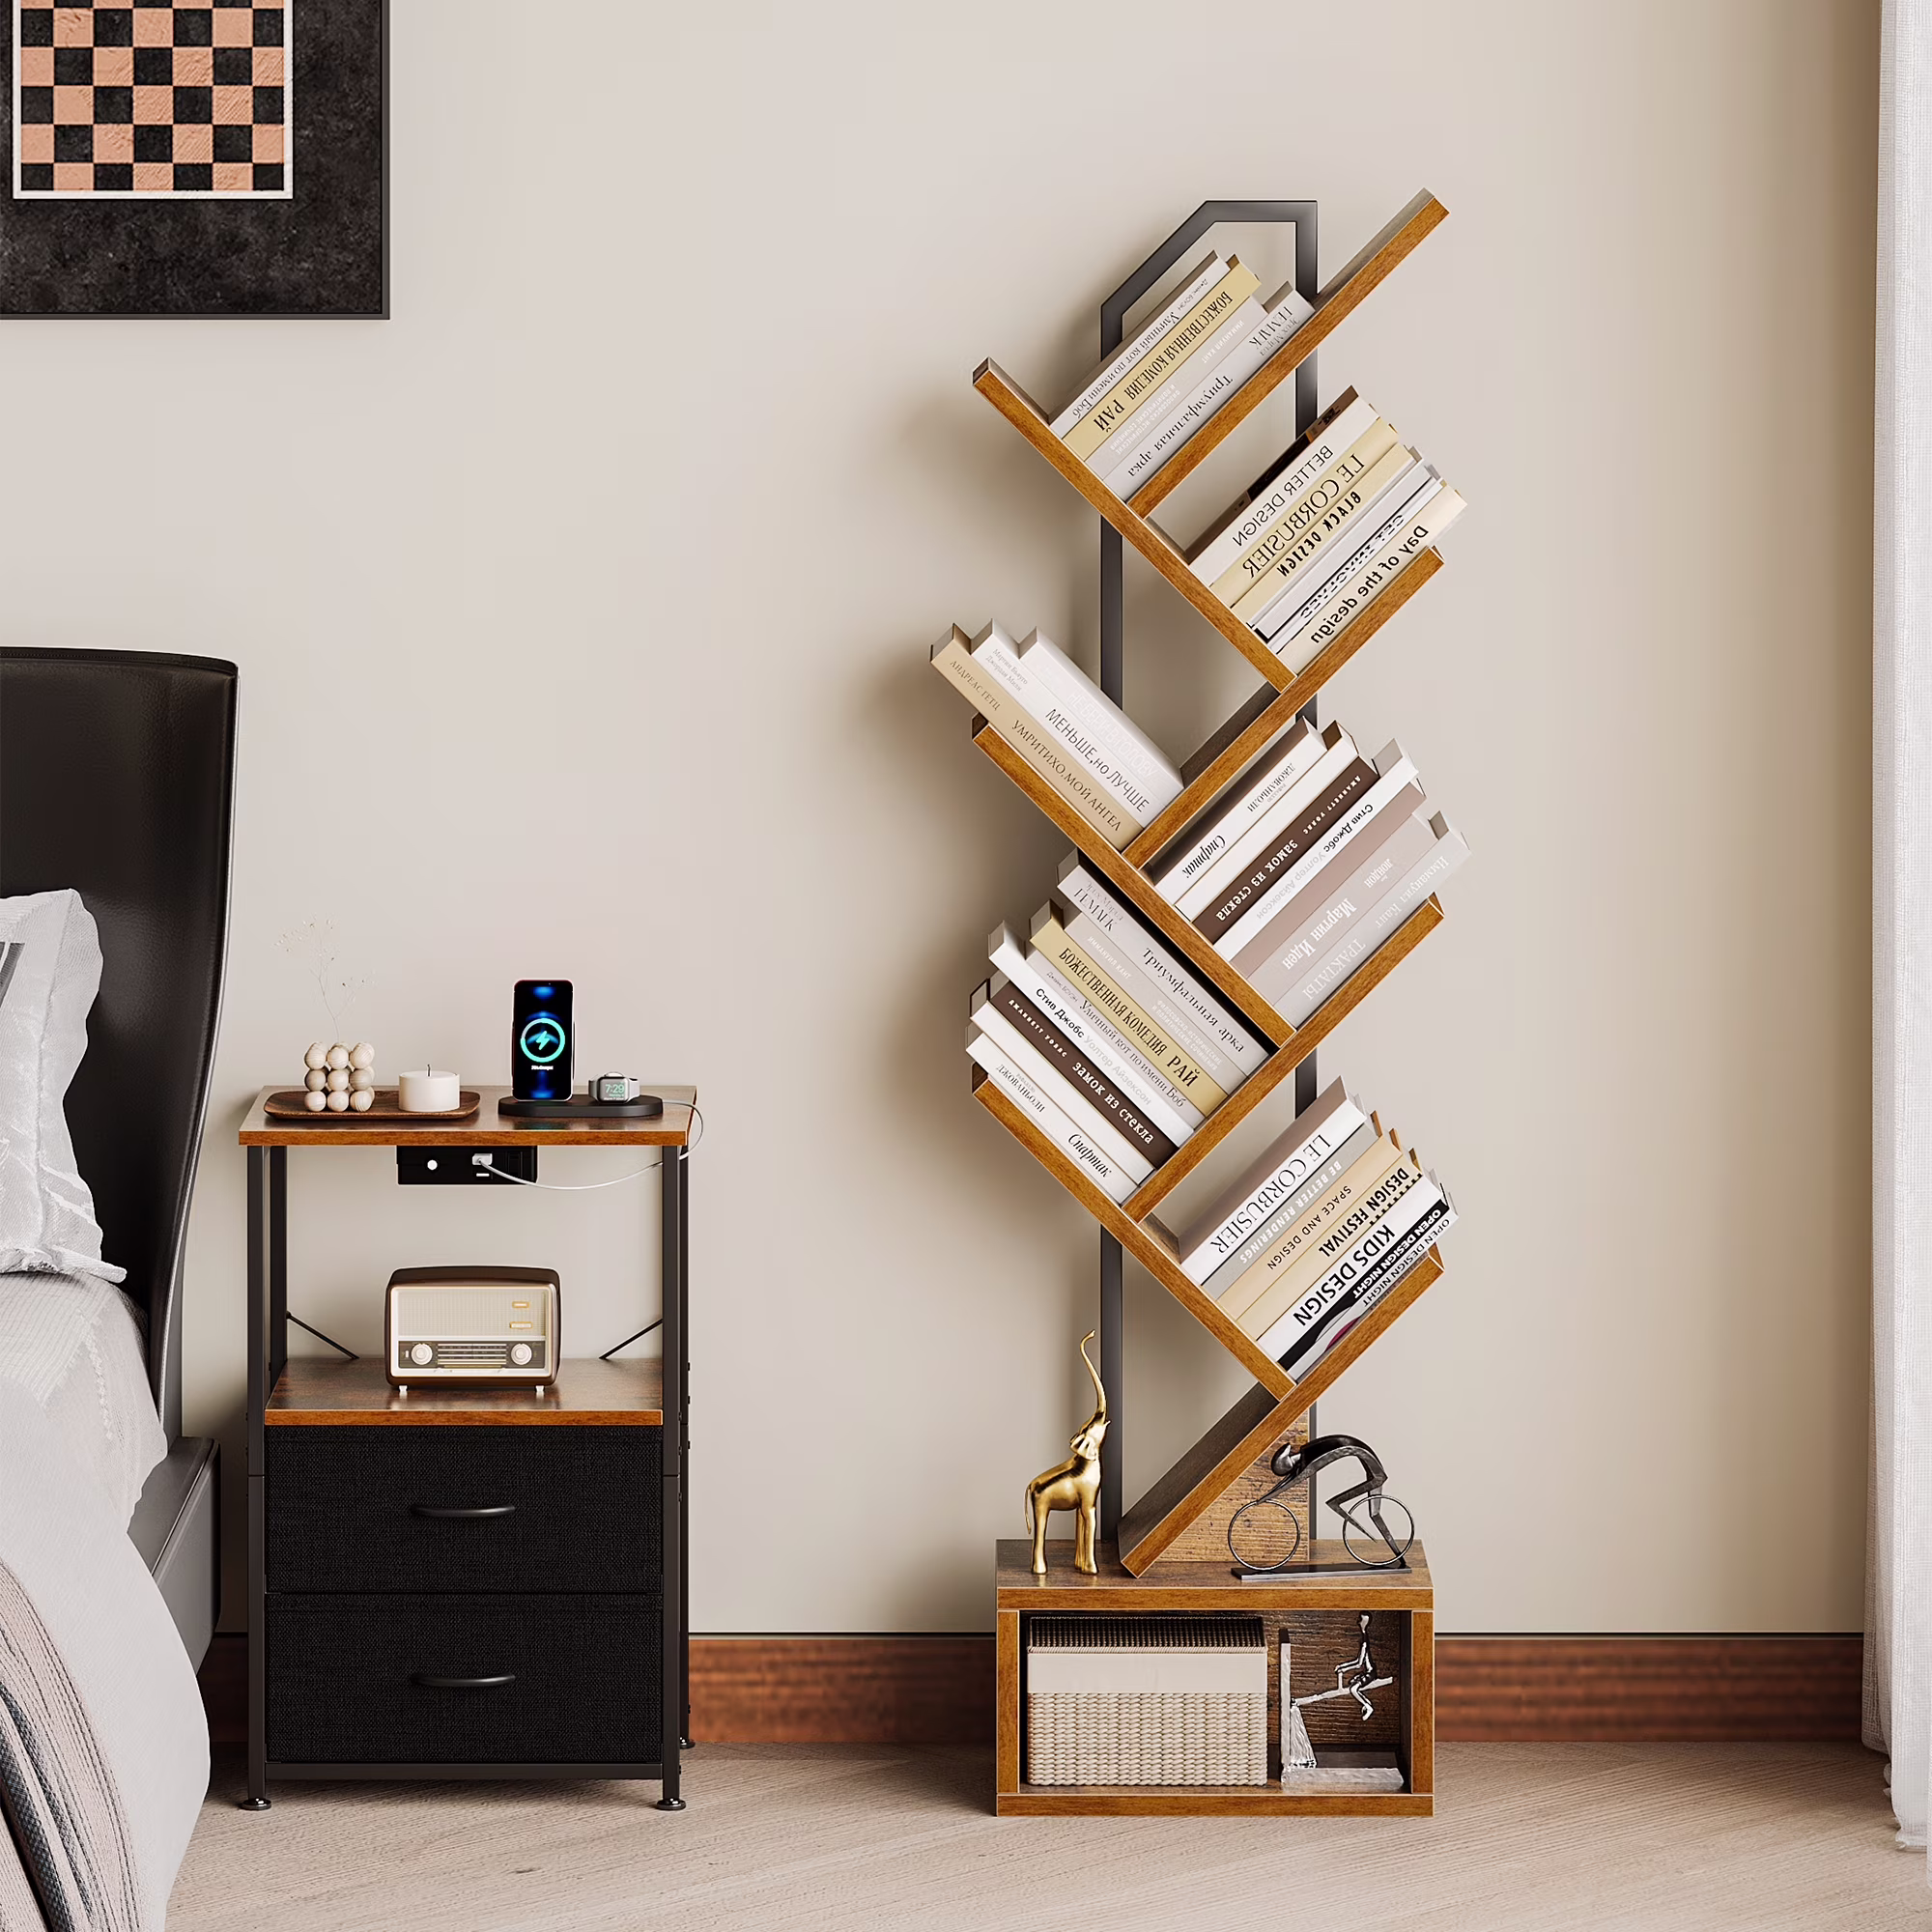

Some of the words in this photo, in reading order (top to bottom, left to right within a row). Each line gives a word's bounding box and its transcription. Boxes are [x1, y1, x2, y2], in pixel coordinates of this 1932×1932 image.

[1139, 311, 1179, 350] Уличный
[1162, 290, 1233, 360] БОЖЕСТВЕННАЯ
[1214, 320, 1244, 350] ИММАНУИЛ
[1113, 360, 1126, 374] по
[1124, 346, 1141, 363] кот
[1200, 348, 1215, 363] КАНТ
[1087, 372, 1116, 400] имени
[1122, 355, 1169, 400] КОМЕДИЯ
[1071, 397, 1093, 419] Боб
[1093, 398, 1124, 433] РАЙ
[1153, 375, 1233, 450] Триумфальная
[1127, 450, 1151, 476] арка
[949, 660, 982, 693] АНДРЕАС
[980, 690, 1001, 711] ГЕТЦ
[1105, 770, 1150, 812] ЛУЧШЕ
[1246, 762, 1294, 811] ДЖОВАНЬОЛИ
[1087, 797, 1121, 831] АНГЕЛ
[1350, 803, 1374, 824] Стив
[1322, 821, 1352, 852] Джобс
[1181, 835, 1225, 878] Спартак
[1264, 838, 1298, 872] замок
[1293, 850, 1326, 881] Уолтер
[1250, 870, 1266, 887] из
[1399, 855, 1448, 903] Иммануил
[1215, 885, 1251, 921] стекла
[1255, 878, 1295, 920] Айзексон
[1374, 903, 1401, 929] Кант
[1309, 897, 1356, 941] Мартин
[1087, 936, 1117, 965] ИММАНУИЛ
[1115, 964, 1130, 980] КАНТ
[1281, 938, 1316, 970] Иден
[1302, 938, 1364, 1000] ТРАКТАТЫ
[1058, 947, 1128, 1016] БОЖЕСТВЕННАЯ
[1122, 1010, 1167, 1056] КОМЕДИЯ
[1166, 1054, 1200, 1087] РАЙ
[1143, 947, 1218, 1026] Триумфальная
[1217, 1028, 1244, 1052] арка
[1035, 987, 1057, 1010] Стив
[1053, 1008, 1084, 1037] Джобс
[1083, 1035, 1113, 1066] Уолтер
[1111, 1065, 1151, 1105] Айзексон
[1078, 999, 1121, 1039] Уличный
[1114, 1037, 1131, 1054] кот
[1128, 1052, 1142, 1065] по
[1140, 1063, 1167, 1092] имени
[1165, 1086, 1188, 1107] Боб
[605, 1084, 625, 1094] 7:29
[995, 1064, 1045, 1112] ДЖОВАНЬОЛИ
[1071, 1061, 1106, 1095] замок
[1103, 1093, 1120, 1109] из
[1118, 1108, 1153, 1144] стекла
[1067, 1133, 1112, 1178] Спартак
[1302, 1133, 1331, 1162] LE
[1327, 1159, 1342, 1176] BE
[1209, 1158, 1306, 1253] CORBUSIER
[1294, 1173, 1329, 1208] BETTER
[1321, 1184, 1351, 1215] SPACE
[1365, 1167, 1409, 1211] DESIGN
[1239, 1206, 1295, 1264] RENDERINGS
[1300, 1213, 1321, 1236] AND
[1318, 1207, 1369, 1257] FESTIVAL
[1413, 1208, 1441, 1236] OPEN
[1423, 1218, 1449, 1244] OPEN
[1266, 1234, 1302, 1269] DESIGN
[1352, 1223, 1395, 1266] KIDS
[1379, 1233, 1416, 1269] DESIGN
[1389, 1242, 1425, 1278] DESIGN
[1293, 1262, 1357, 1325] DESIGN
[1351, 1266, 1382, 1298] NIGHT
[1362, 1276, 1391, 1307] NIGHT
